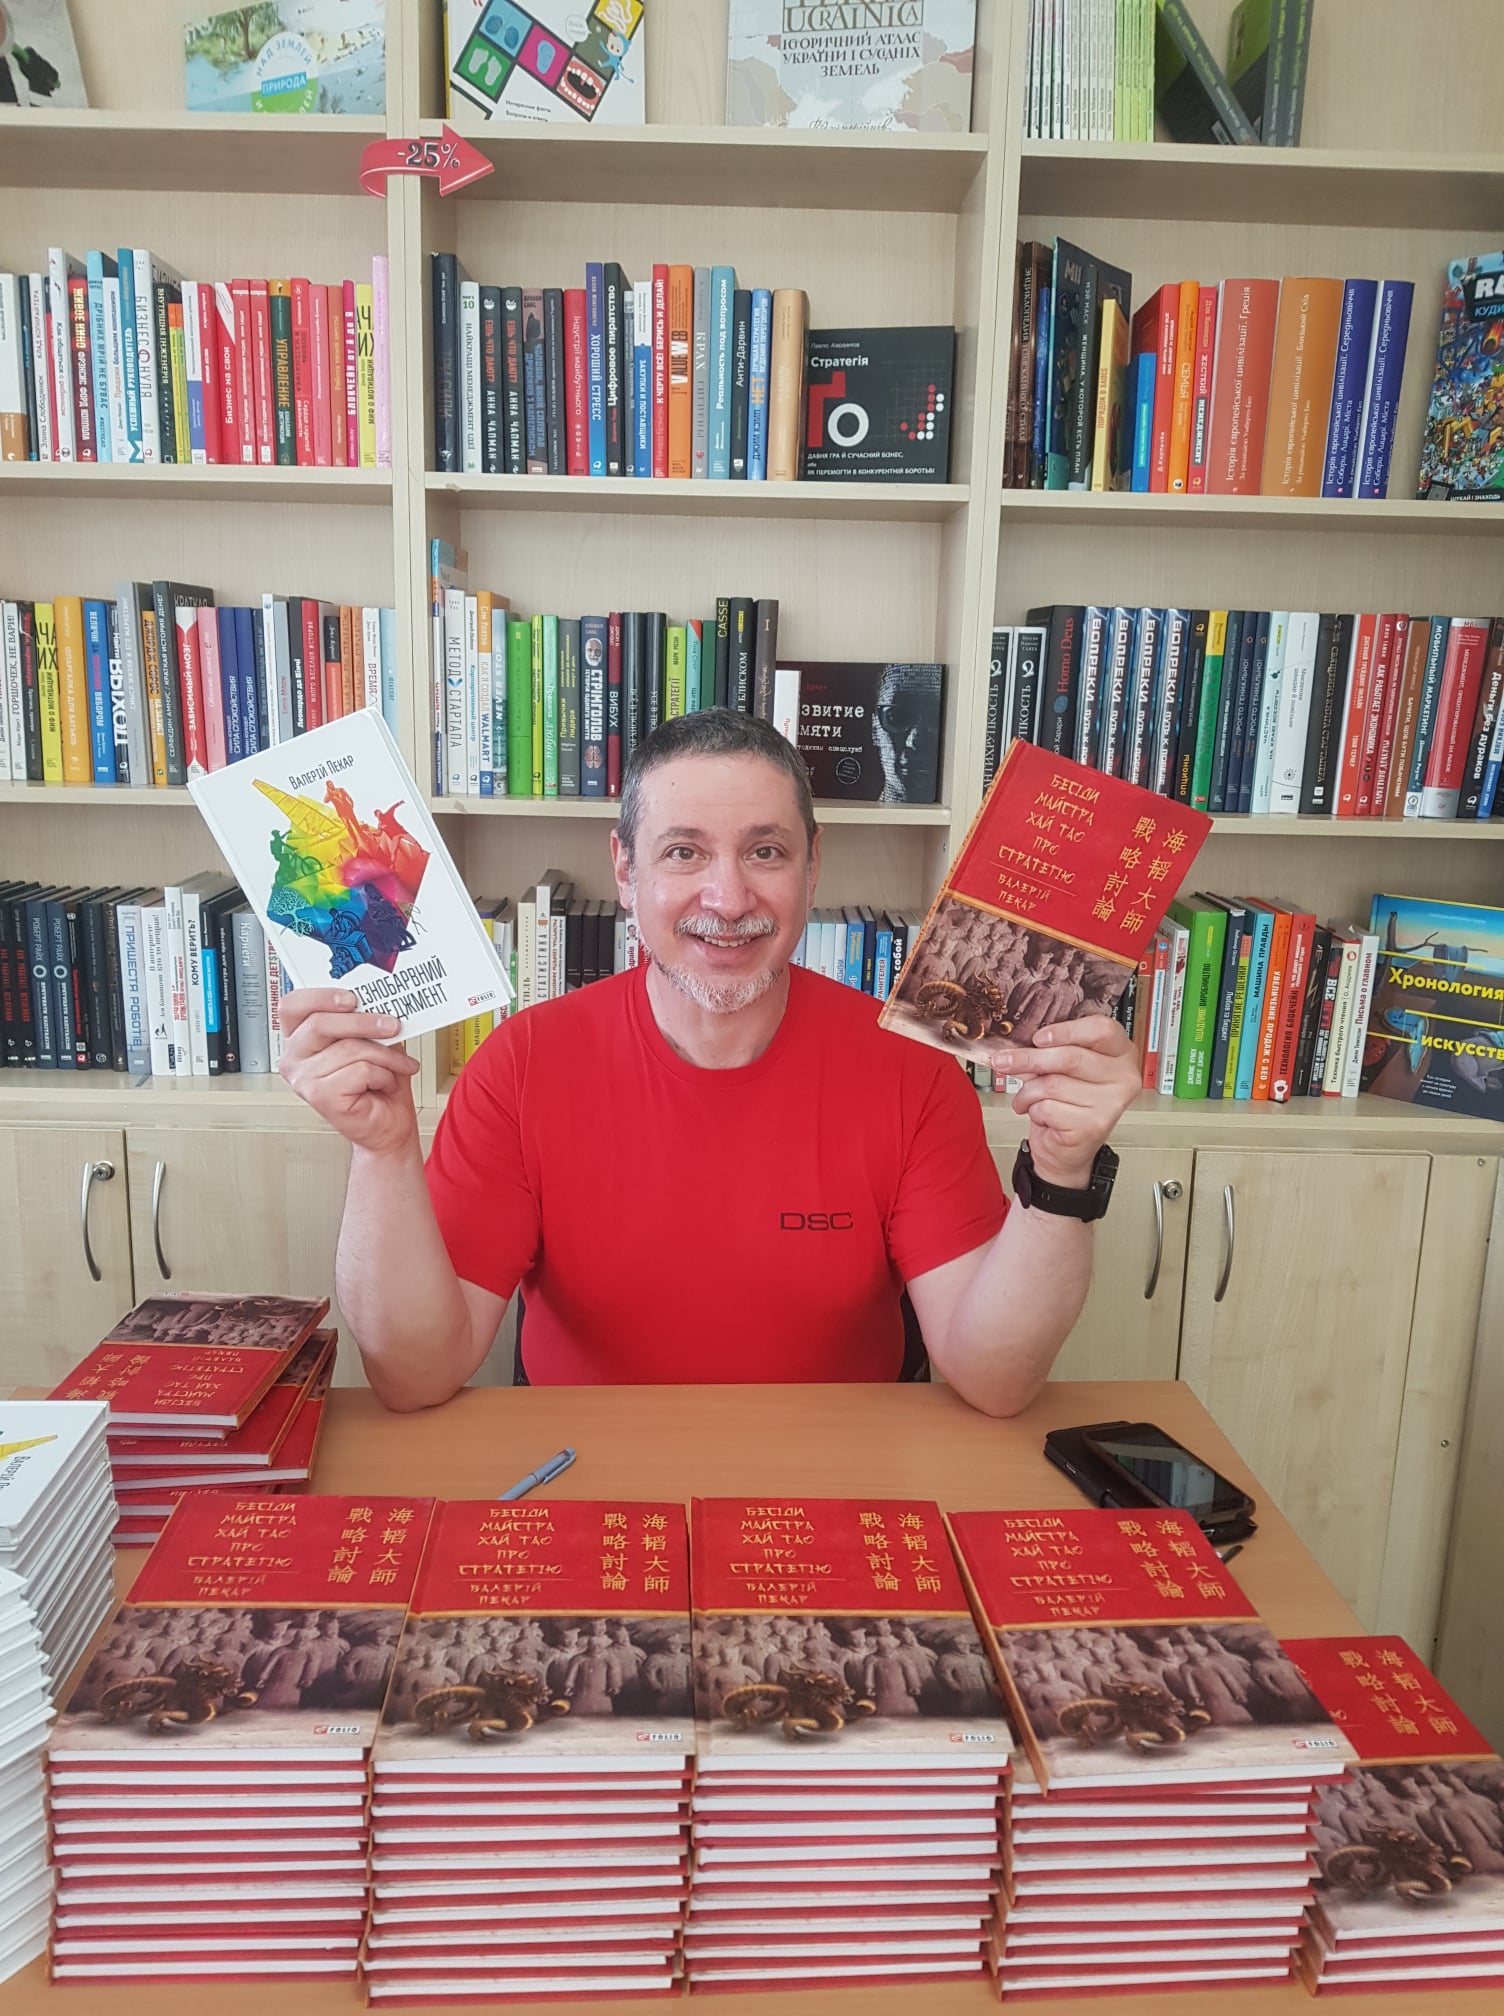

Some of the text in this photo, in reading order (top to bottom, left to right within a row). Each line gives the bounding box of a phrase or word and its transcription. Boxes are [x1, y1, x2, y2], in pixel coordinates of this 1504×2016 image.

[876, 32, 921, 45] АТЛАС
[783, 49, 847, 64] УКРАЇНИ
[821, 63, 880, 77] ЗЕМЕЛЬ
[262, 75, 306, 93] ПРИРОДА
[397, 142, 460, 168] -25%
[656, 279, 664, 309] ДЕЛАЙ!
[1240, 286, 1252, 319] Греція
[73, 288, 86, 349] ЖИВОЕ КИНО
[135, 296, 153, 398] БИЗНЕС НУЛЯ
[485, 340, 494, 354] ЧТО
[507, 340, 516, 355] ЧТО
[607, 285, 616, 406] Цифровое пиратство
[736, 321, 746, 388] Анти-Дарвин
[276, 338, 291, 408] УПРАВЛЕНИЕ
[811, 355, 869, 368] Стратегія
[125, 327, 138, 432] УСПЕШНЫЙ РУКОВОДИТЕЛЬ
[225, 373, 231, 385] на
[590, 334, 600, 421] ХОРОШИЙ СТРЕСС
[716, 353, 725, 409] Реальность
[752, 376, 766, 405] НЕТ
[225, 387, 233, 424] Бизнес
[487, 391, 495, 415] АННА
[509, 391, 517, 415] АННА
[1194, 354, 1208, 464] ЖЕСТКИЙ МЕНЕДЖМЕНТ
[1230, 379, 1245, 445] європейської
[488, 421, 497, 459] ЧАПМАН
[510, 421, 519, 460] ЧАПМАН
[1225, 447, 1238, 481] Історія
[1057, 617, 1074, 693] Homo Deus
[1086, 619, 1102, 702] ВОПРЕКИ
[1114, 619, 1129, 702] ВОПРЕКИ
[1141, 619, 1156, 702] ВОПРЕКИ
[1168, 619, 1183, 702] ВОПРЕКИ
[182, 643, 196, 731] ЗАВИСИМЫЙ МОЗГ
[448, 637, 462, 748] МЕТОД СТАРТАПА
[494, 647, 504, 720] NEVER STOP
[1420, 625, 1443, 736] МОБИЛЬНЫЙ МАРКЕТИНГ
[229, 675, 241, 753] СИЛА СПОКОЙСТВИЯ
[246, 676, 258, 753] СИЛА СПОКОЙСТВИЯ
[590, 669, 603, 742] СТРІМГОЛОВ
[609, 691, 619, 728] ВИБУХ
[802, 705, 864, 718] звитие
[481, 713, 490, 763] WALMART
[1473, 672, 1501, 780] Деньги без дураков
[289, 755, 354, 790] ВАЛЕРІЙ ПЕКАР
[1180, 754, 1189, 795] опционы
[1050, 774, 1100, 804] БЕСІДИ
[1034, 792, 1095, 826] МАЙСТРА
[1026, 812, 1085, 843] ХАЙ ТАО
[1032, 835, 1060, 856] ПРО
[998, 845, 1076, 884] СТРАТЕГІЮ
[998, 873, 1051, 902] ВАЛЕРІЙ
[999, 890, 1037, 912] ПЕКАР
[188, 919, 199, 986] КОМУ ВЕРИТЬ?
[240, 922, 251, 967] Карнеги
[1253, 924, 1269, 998] МАШИНА ПРАВДЫ
[125, 925, 142, 1047] ПРИШЕСТЯ РОБОТІВ
[350, 955, 447, 1008] ІЗНОБАРВНИЙ
[1355, 952, 1372, 1025] Письма главном
[1388, 967, 1504, 1000] Хронология
[1230, 965, 1246, 1039] ПРИНЯТИЕ РЕШЕНИЙ
[1263, 971, 1281, 1056] УВЕЛИЧЕНИЕ ПРОДАЖ
[1279, 990, 1298, 1075] ТЕХНОЛОГИЯ БЛОКЧЕЙН
[780, 1212, 853, 1230] DSC
[220, 1514, 297, 1525] МАЙСТРА
[235, 1502, 295, 1512] БЕСІДИ
[490, 1508, 549, 1518] БЕСІДИ
[746, 1507, 805, 1517] БЕСІДИ
[215, 1527, 292, 1538] ХАЙ ТАО
[480, 1520, 555, 1532] МАЙСТРА
[740, 1518, 815, 1531] МАЙСТРА
[1004, 1518, 1064, 1528] БЕСІДИ
[1004, 1531, 1079, 1543] МАЙСТРА
[230, 1543, 263, 1552] ПРО
[477, 1534, 552, 1546] ХАЙ ТАО
[742, 1532, 814, 1545] ХАЙ ТАО
[1010, 1545, 1083, 1557] ХАЙ ТАО
[187, 1557, 294, 1568] СТРАТЕГІЮ
[497, 1550, 529, 1560] ПРО
[729, 1563, 832, 1574] СТРАТЕГІЮ
[764, 1549, 797, 1559] ПРО
[1037, 1560, 1072, 1572] ПРО
[193, 1575, 267, 1586] ВАЛЕРІЙ
[459, 1564, 563, 1575] СТРАТЕГІЮ
[1010, 1574, 1112, 1587] СТРАТЕГІЮ
[199, 1587, 251, 1598] ПЕКАР
[470, 1583, 542, 1593] ВАЛЕРІЙ
[480, 1596, 530, 1605] ПЕКАР
[746, 1581, 817, 1592] ВАЛЕРІЙ
[758, 1595, 809, 1605] ПЕКАР
[1033, 1593, 1105, 1605] ВАЛЕРІЙ
[1050, 1606, 1101, 1617] ПЕКАР
